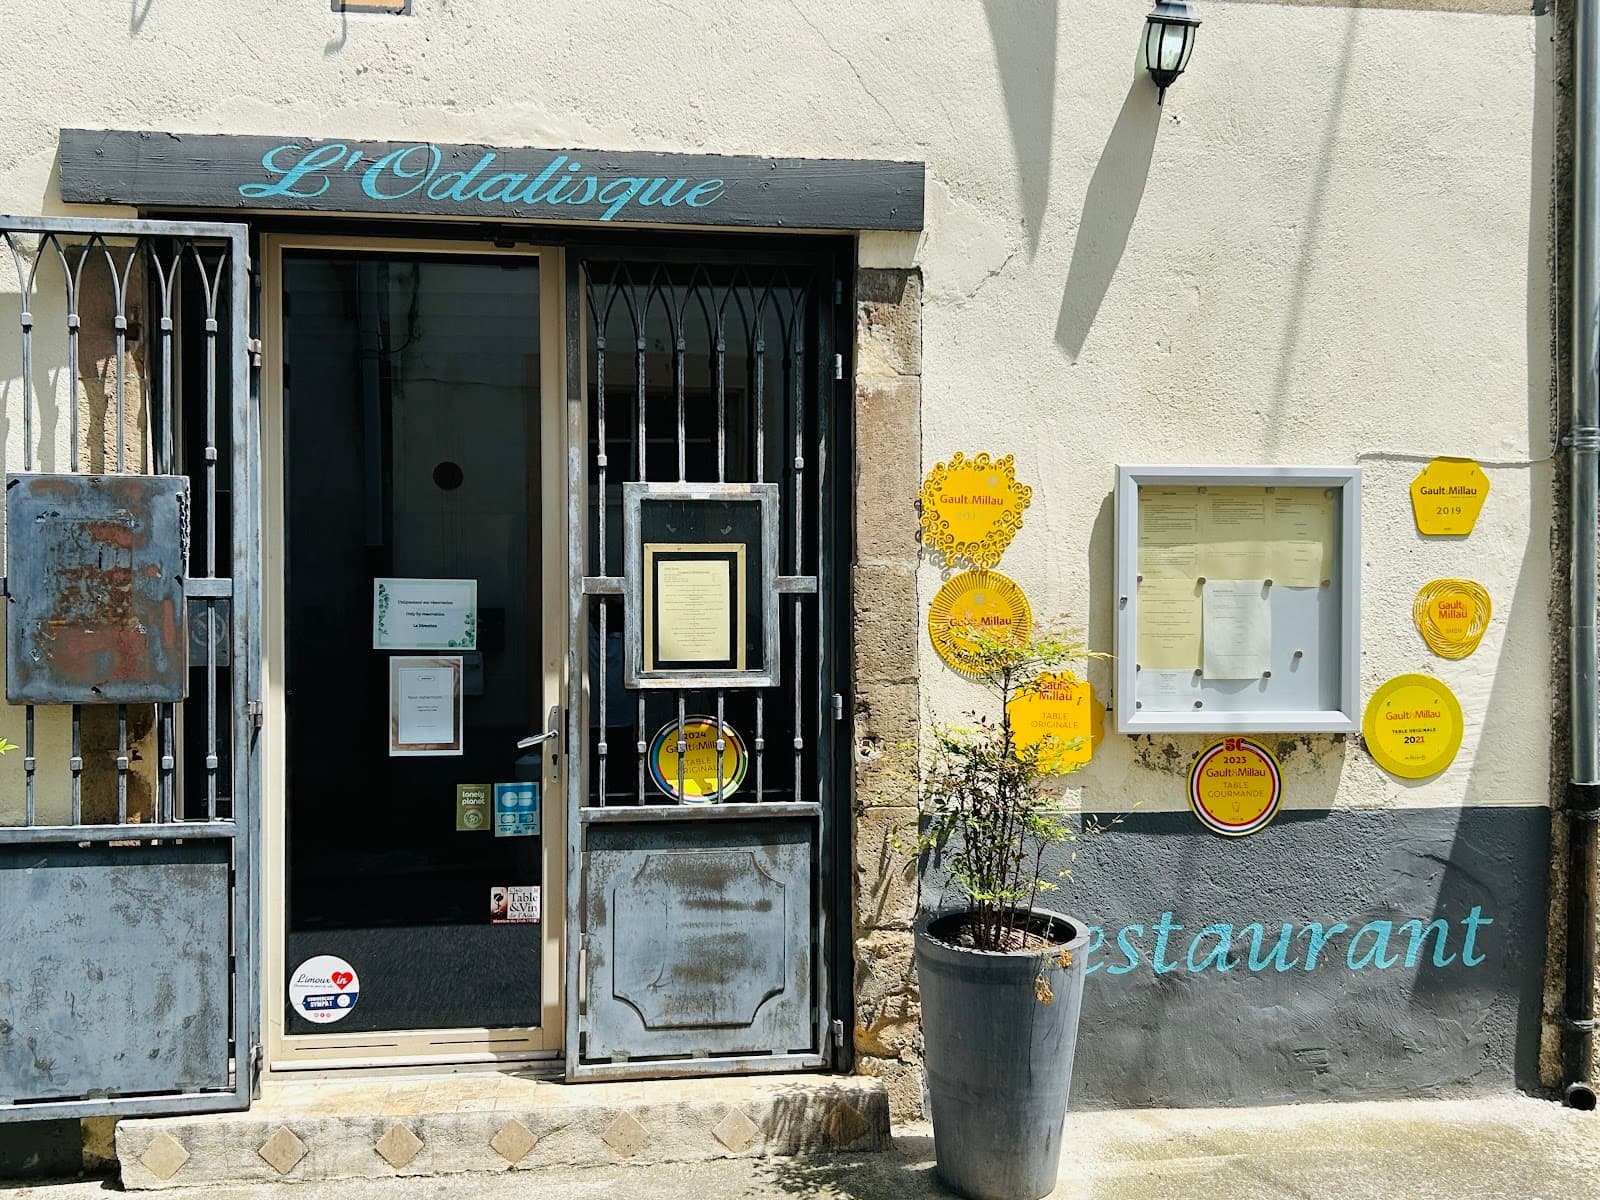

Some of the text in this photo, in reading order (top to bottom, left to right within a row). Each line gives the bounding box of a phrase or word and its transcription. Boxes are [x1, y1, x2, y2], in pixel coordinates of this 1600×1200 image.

[238, 143, 725, 221] L'Odalisque
[1436, 506, 1462, 515] 2019
[1438, 609, 1468, 619] Millau
[981, 616, 1012, 626] Millau
[1043, 712, 1068, 721] TABLE
[1031, 721, 1079, 730] ORIGINALE
[684, 731, 706, 740] 2024
[1404, 736, 1424, 744] 2021
[462, 791, 485, 800] lonely
[1207, 790, 1265, 798] GOURMANDE
[461, 798, 486, 806] planet
[509, 893, 538, 902] Table
[1085, 905, 1495, 977] estaurant
[296, 973, 331, 984] Limoux
